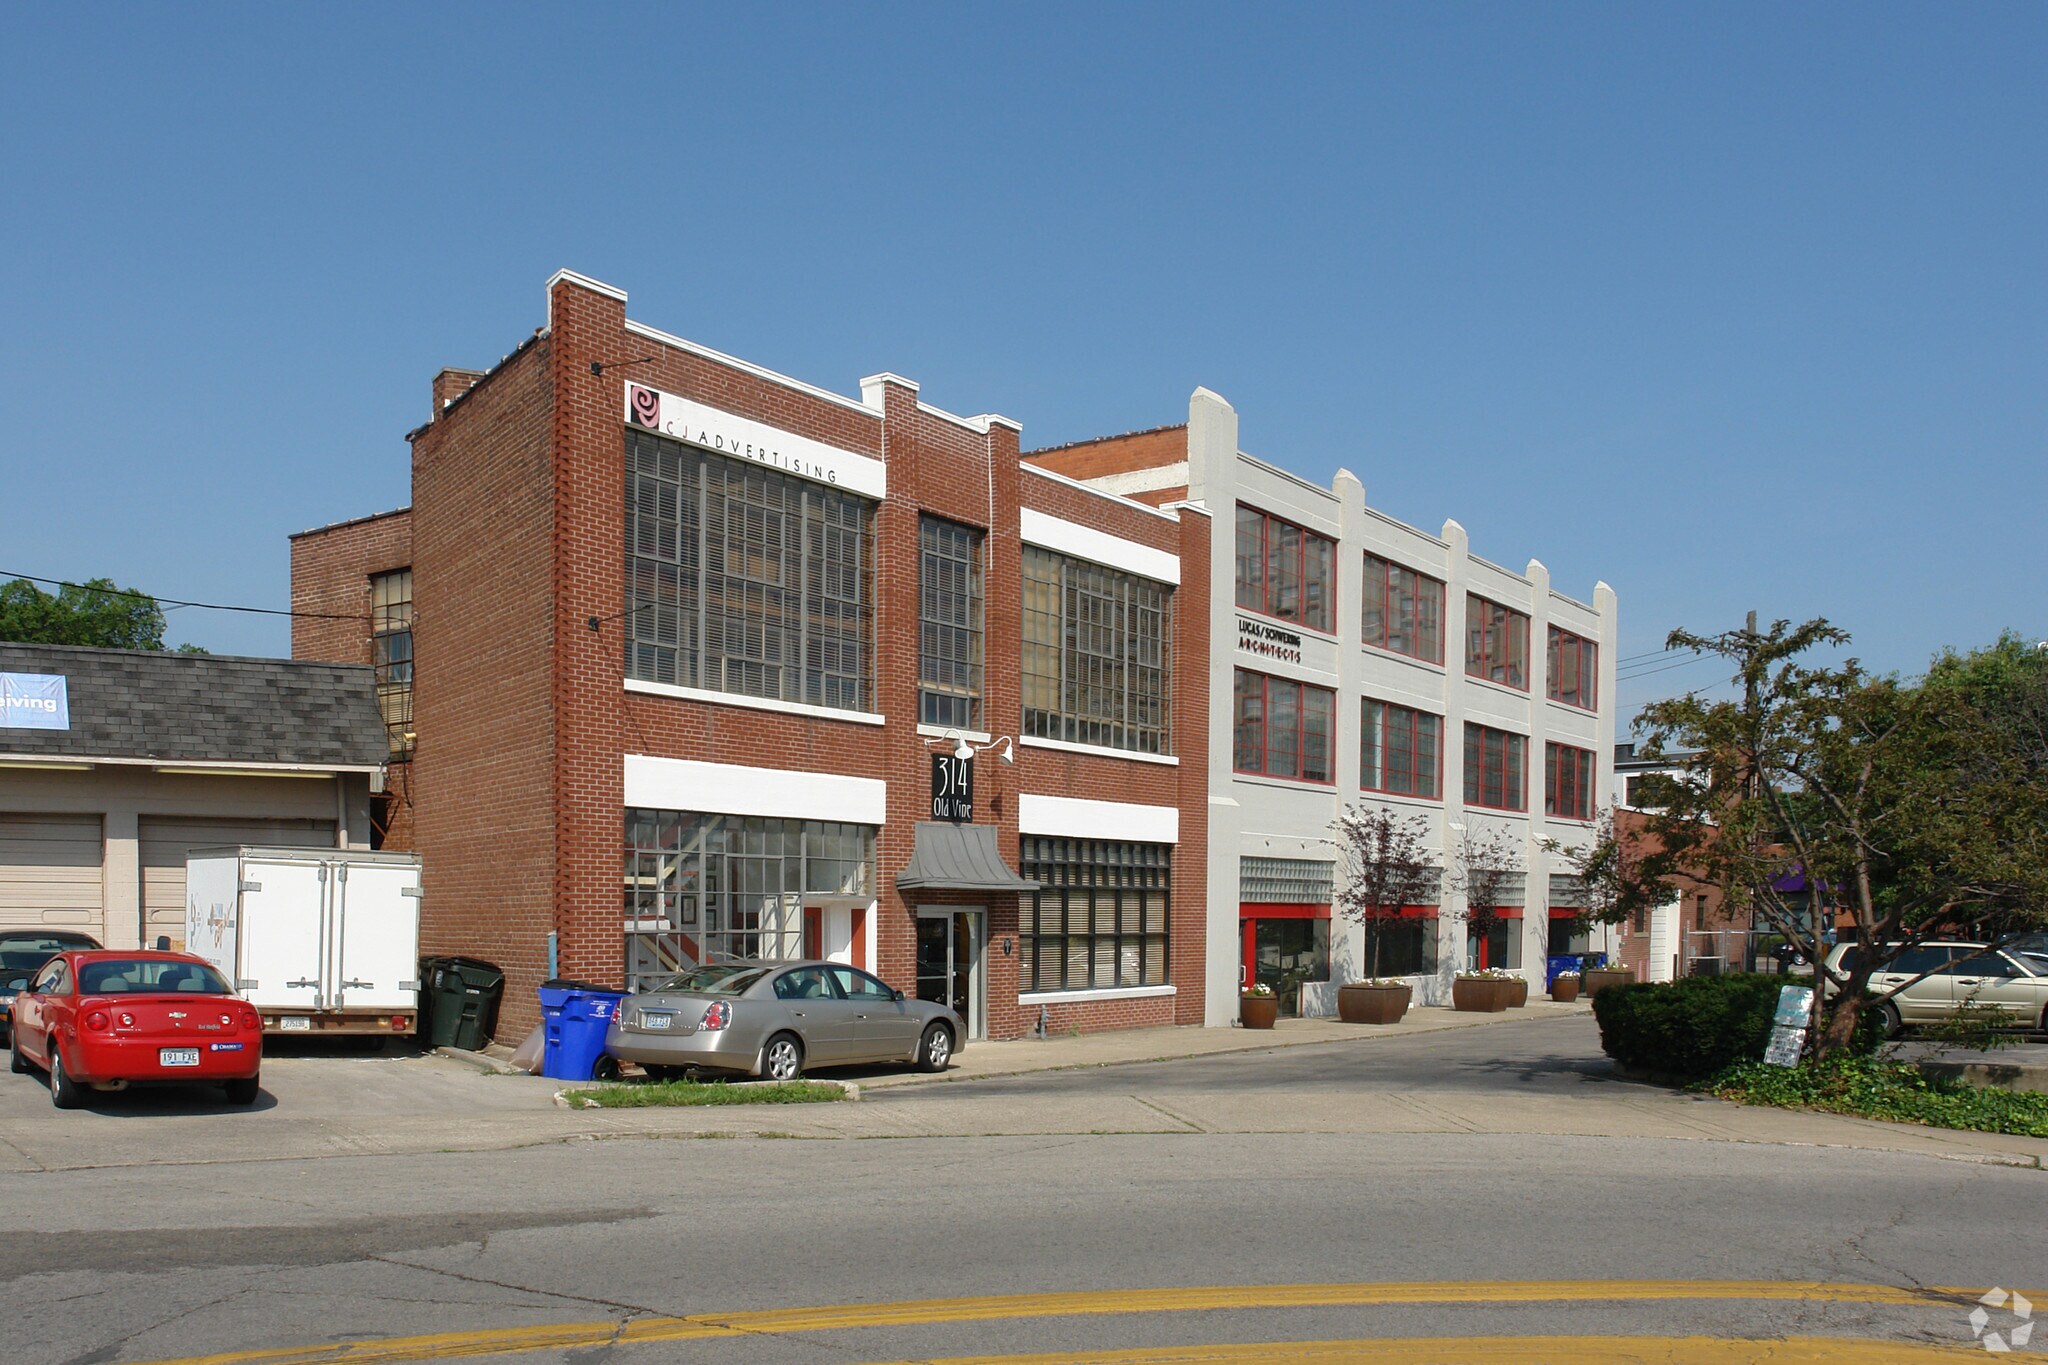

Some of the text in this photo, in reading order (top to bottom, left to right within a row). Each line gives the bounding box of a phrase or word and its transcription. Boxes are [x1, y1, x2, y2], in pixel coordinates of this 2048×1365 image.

[699, 431, 836, 483] ADVERTISING
[939, 757, 968, 797] 314
[933, 797, 972, 819] Old Vine
[163, 1052, 177, 1061] 191
